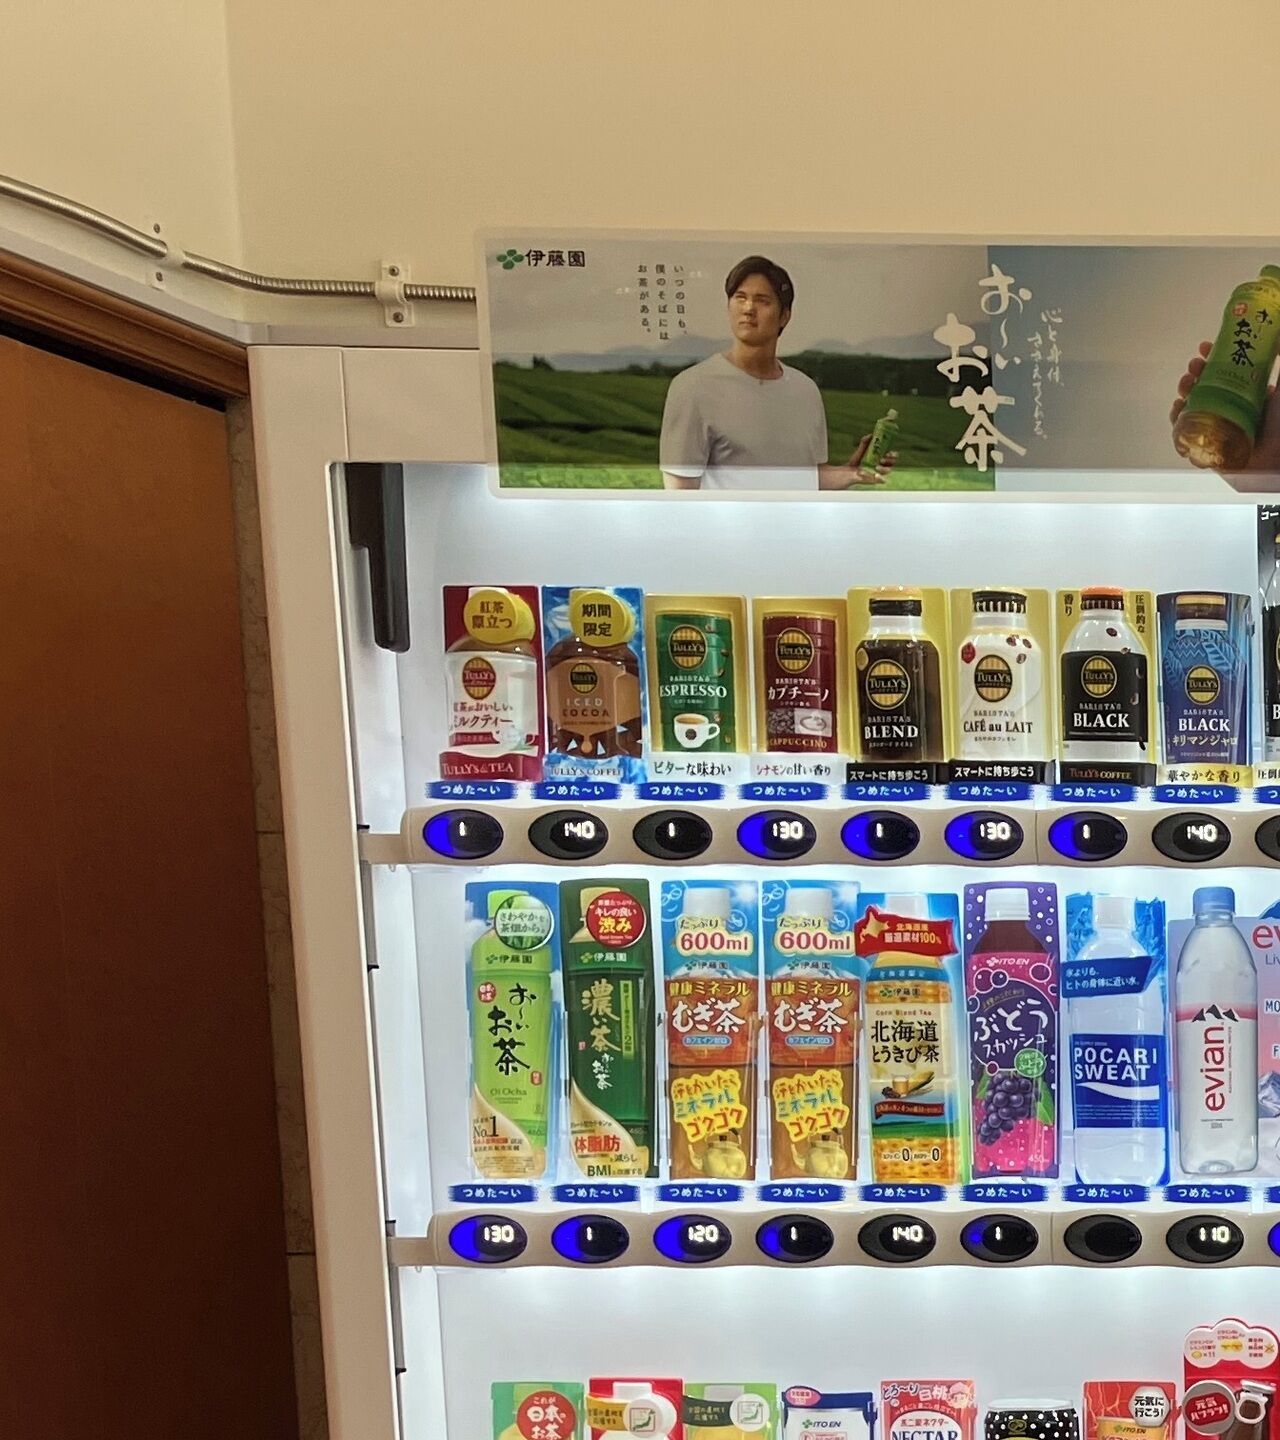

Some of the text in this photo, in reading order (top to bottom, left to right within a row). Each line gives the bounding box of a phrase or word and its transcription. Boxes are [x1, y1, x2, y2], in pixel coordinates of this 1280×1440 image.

[525, 250, 586, 268] 伊藤園
[933, 312, 1028, 473] お茶
[581, 603, 613, 618] 期間
[582, 622, 613, 637] 限定
[767, 685, 830, 702] カプチーノ
[1072, 712, 1131, 729] BLACK
[1178, 717, 1231, 732] BLACK
[864, 725, 920, 739] BLEND
[653, 761, 732, 777] ビターな味わい
[849, 770, 929, 782] スマートに持ち歩こう
[954, 766, 1035, 778] スマートに持ち歩こう
[1167, 769, 1241, 783] 華やかな香り
[772, 821, 804, 840] 130
[1186, 824, 1219, 841] 140
[598, 917, 633, 934] 渋み
[680, 930, 749, 952] 600ml
[779, 930, 851, 952] 600ml
[668, 980, 751, 998] 健康ミネラル
[770, 980, 853, 998] 健康ミネラル
[671, 998, 746, 1034] むぎ茶
[773, 998, 849, 1034] むぎ茶
[972, 1000, 1050, 1043] ぶどう
[870, 1019, 940, 1043] 北海道
[871, 1044, 941, 1063] とうきび茶
[1073, 1046, 1158, 1064] POCARI
[1073, 1064, 1152, 1081] SWEAT
[1198, 1026, 1227, 1113] evian
[573, 1134, 621, 1153] 体脂肪
[587, 1164, 612, 1177] BMI
[483, 1225, 515, 1243] 130
[687, 1224, 719, 1243] 120
[891, 1224, 923, 1242] 140
[1134, 1395, 1165, 1407] 元気に
[530, 1424, 562, 1440] お茶
